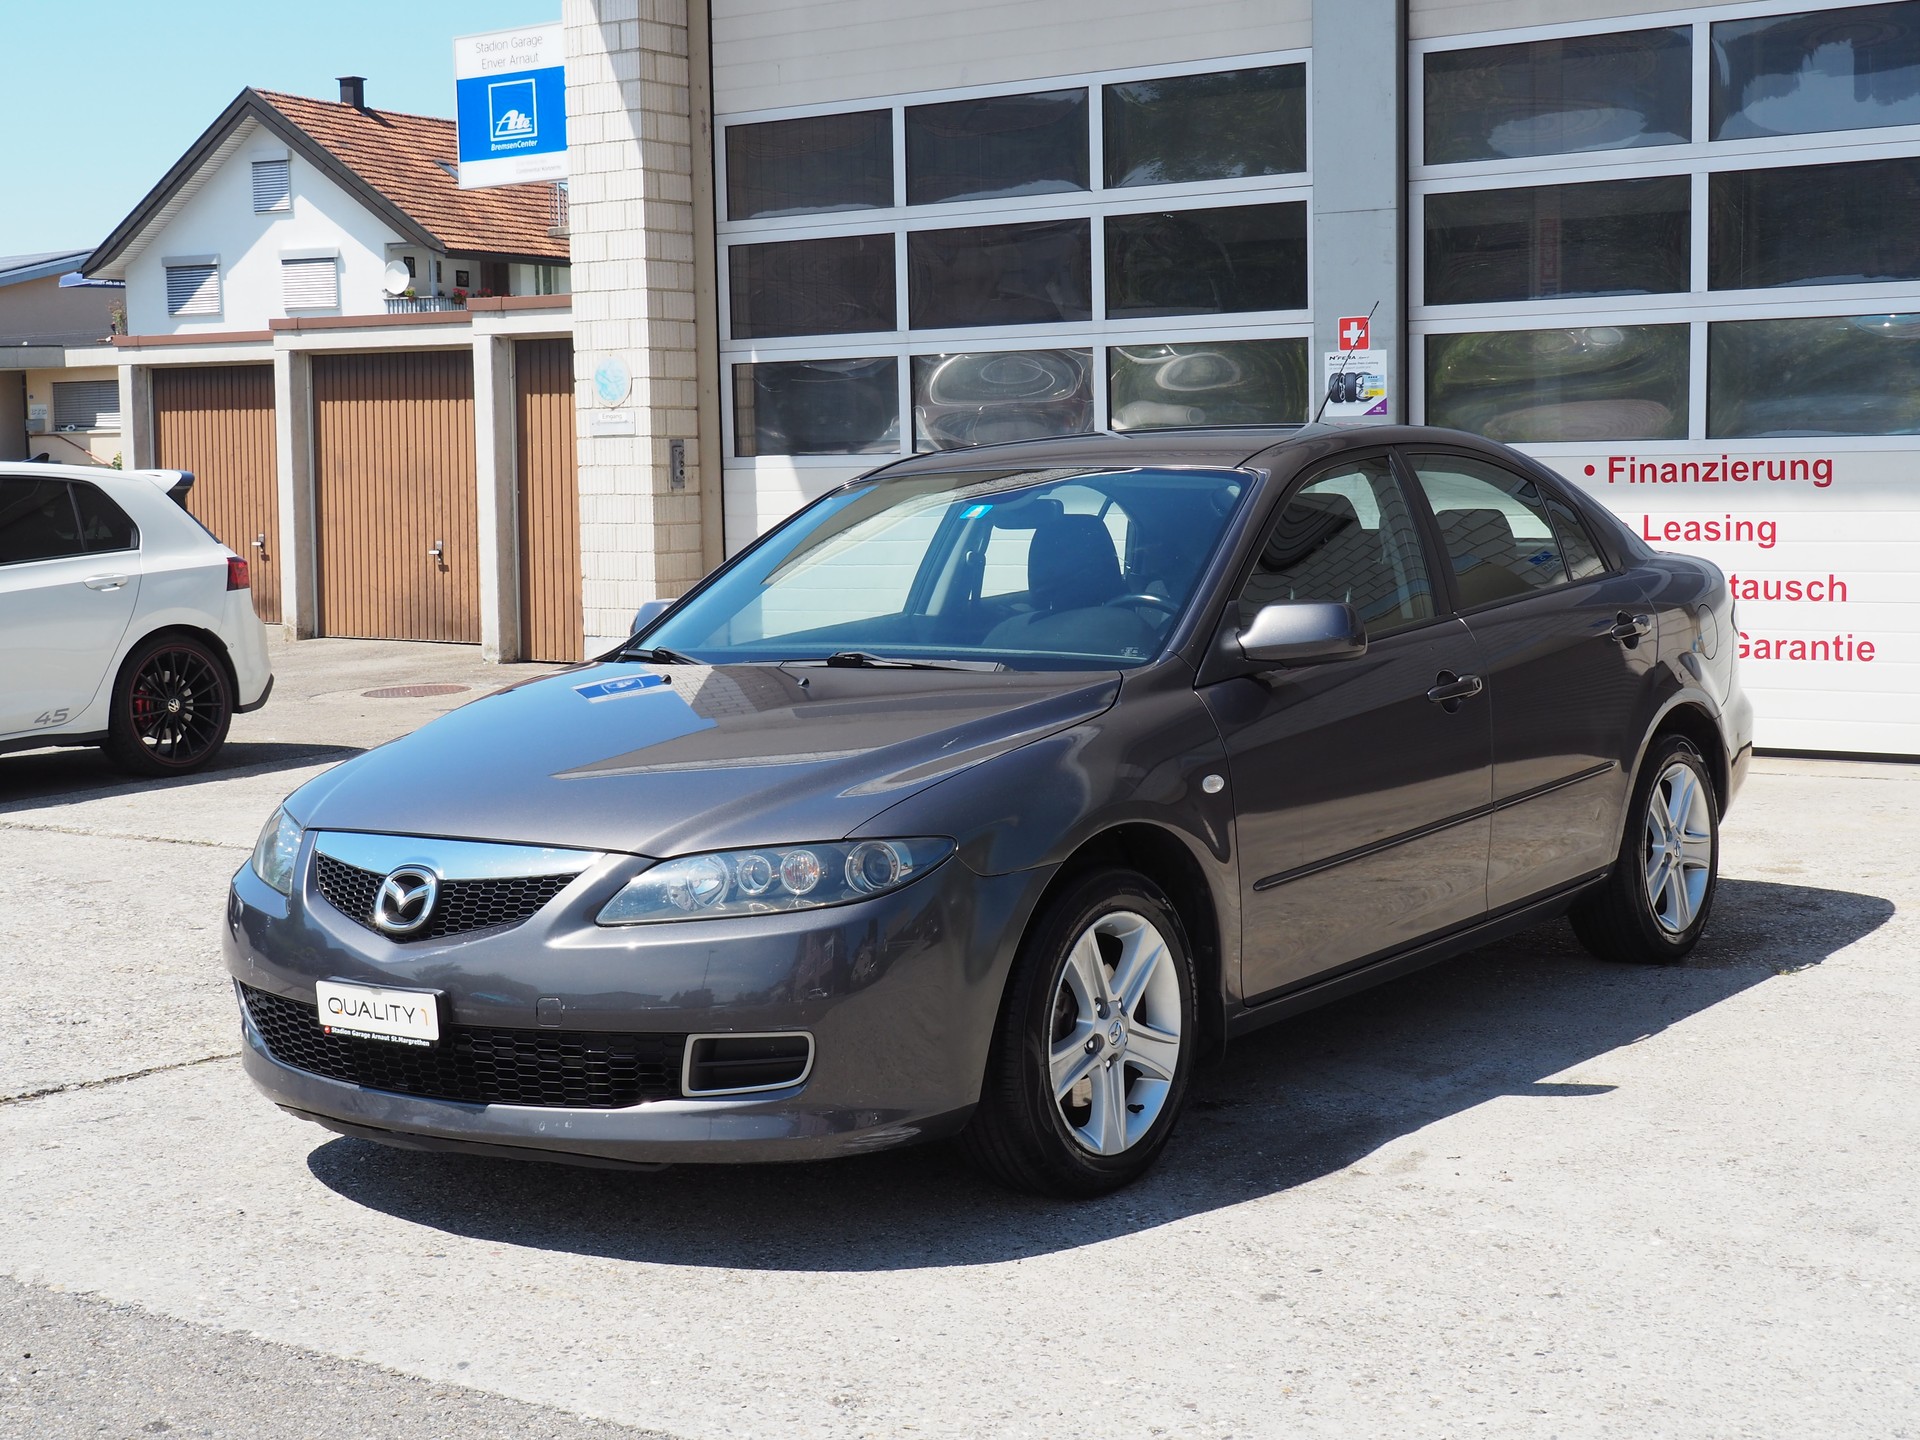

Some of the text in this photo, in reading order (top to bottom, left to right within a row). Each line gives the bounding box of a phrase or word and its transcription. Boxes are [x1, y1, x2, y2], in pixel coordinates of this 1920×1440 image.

[476, 35, 543, 54] Stadion Garage
[481, 53, 539, 70] Enver Arnaut
[491, 139, 538, 152] BremsenCenter
[1608, 454, 1833, 488] Finanzierung
[1643, 514, 1777, 549] Leasing
[34, 708, 70, 725] 45
[328, 997, 415, 1024] QUALITY
[331, 1026, 351, 1035] Stadion
[352, 1029, 371, 1039] Garage
[371, 1032, 390, 1041] Arnaut
